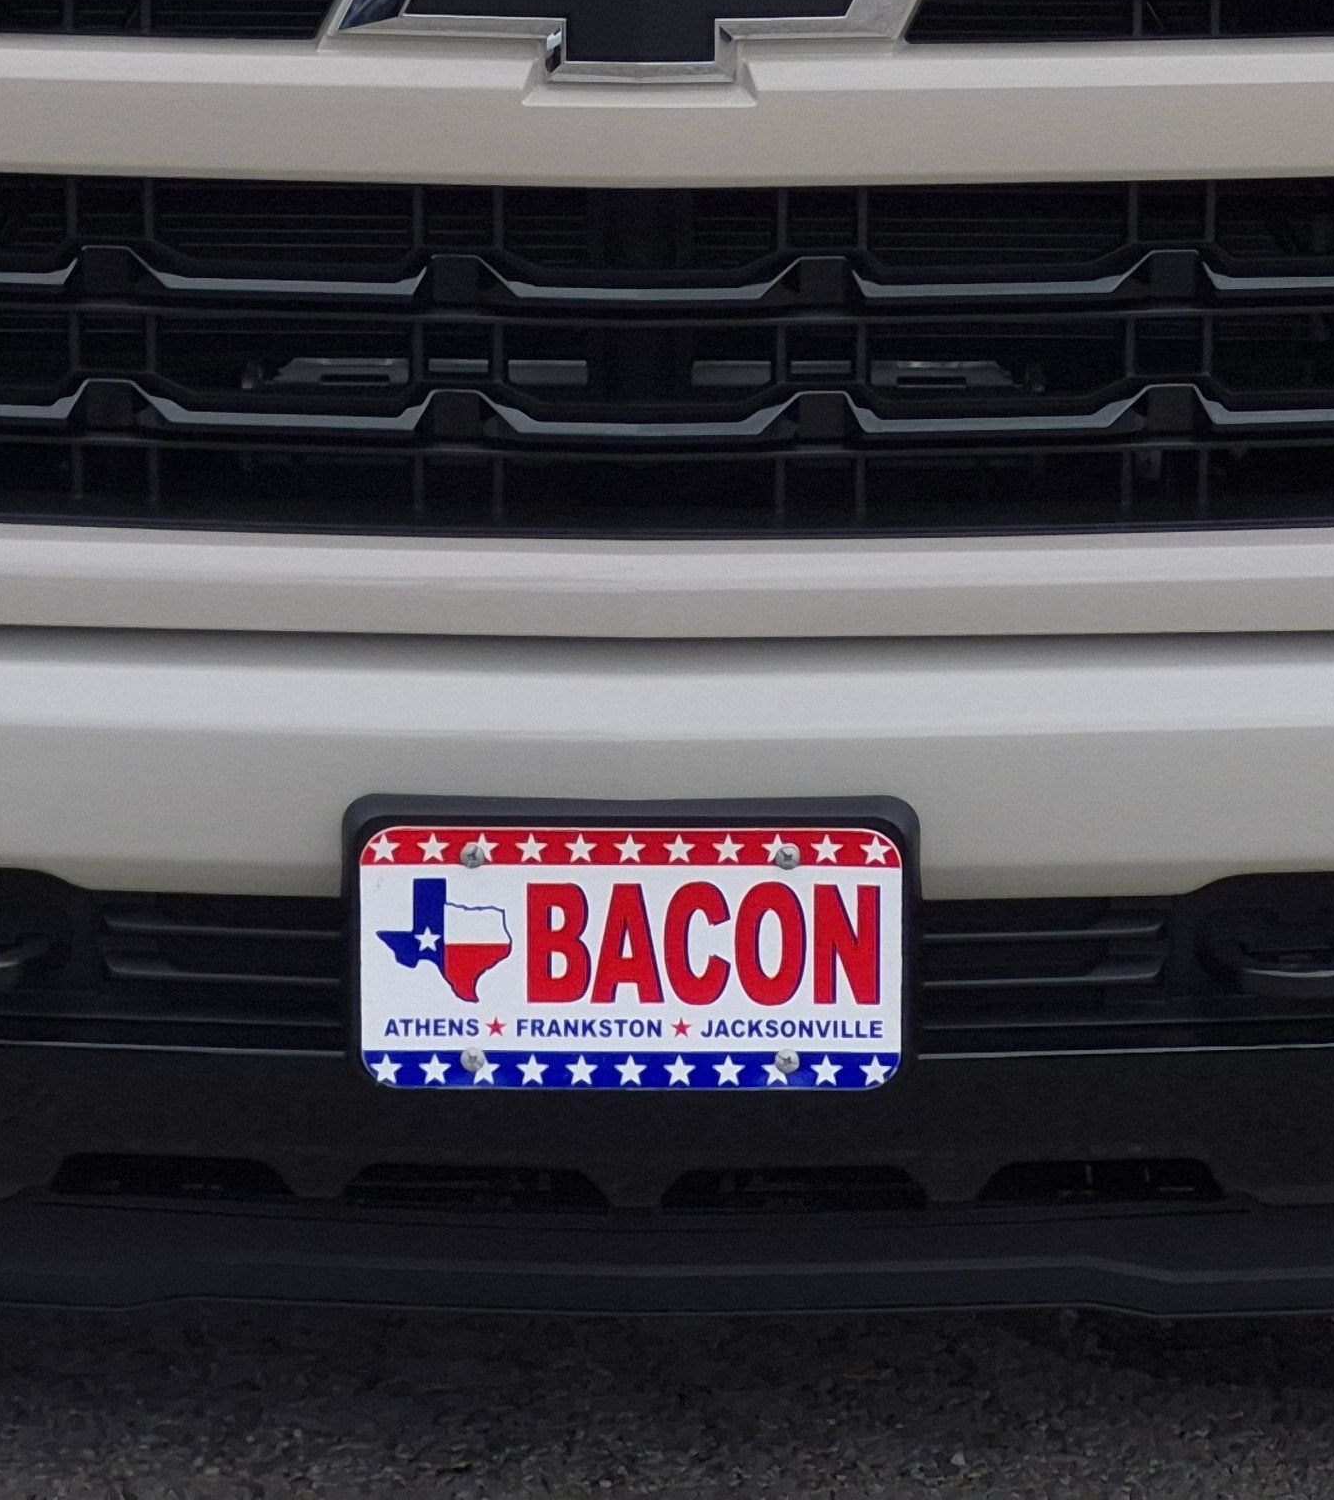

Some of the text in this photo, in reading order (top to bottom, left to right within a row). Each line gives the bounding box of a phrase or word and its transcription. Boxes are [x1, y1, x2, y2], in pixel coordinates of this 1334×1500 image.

[526, 881, 881, 1007] BACON
[383, 1018, 884, 1039] ATHENS FRANKSTON JACKSONVILLE
